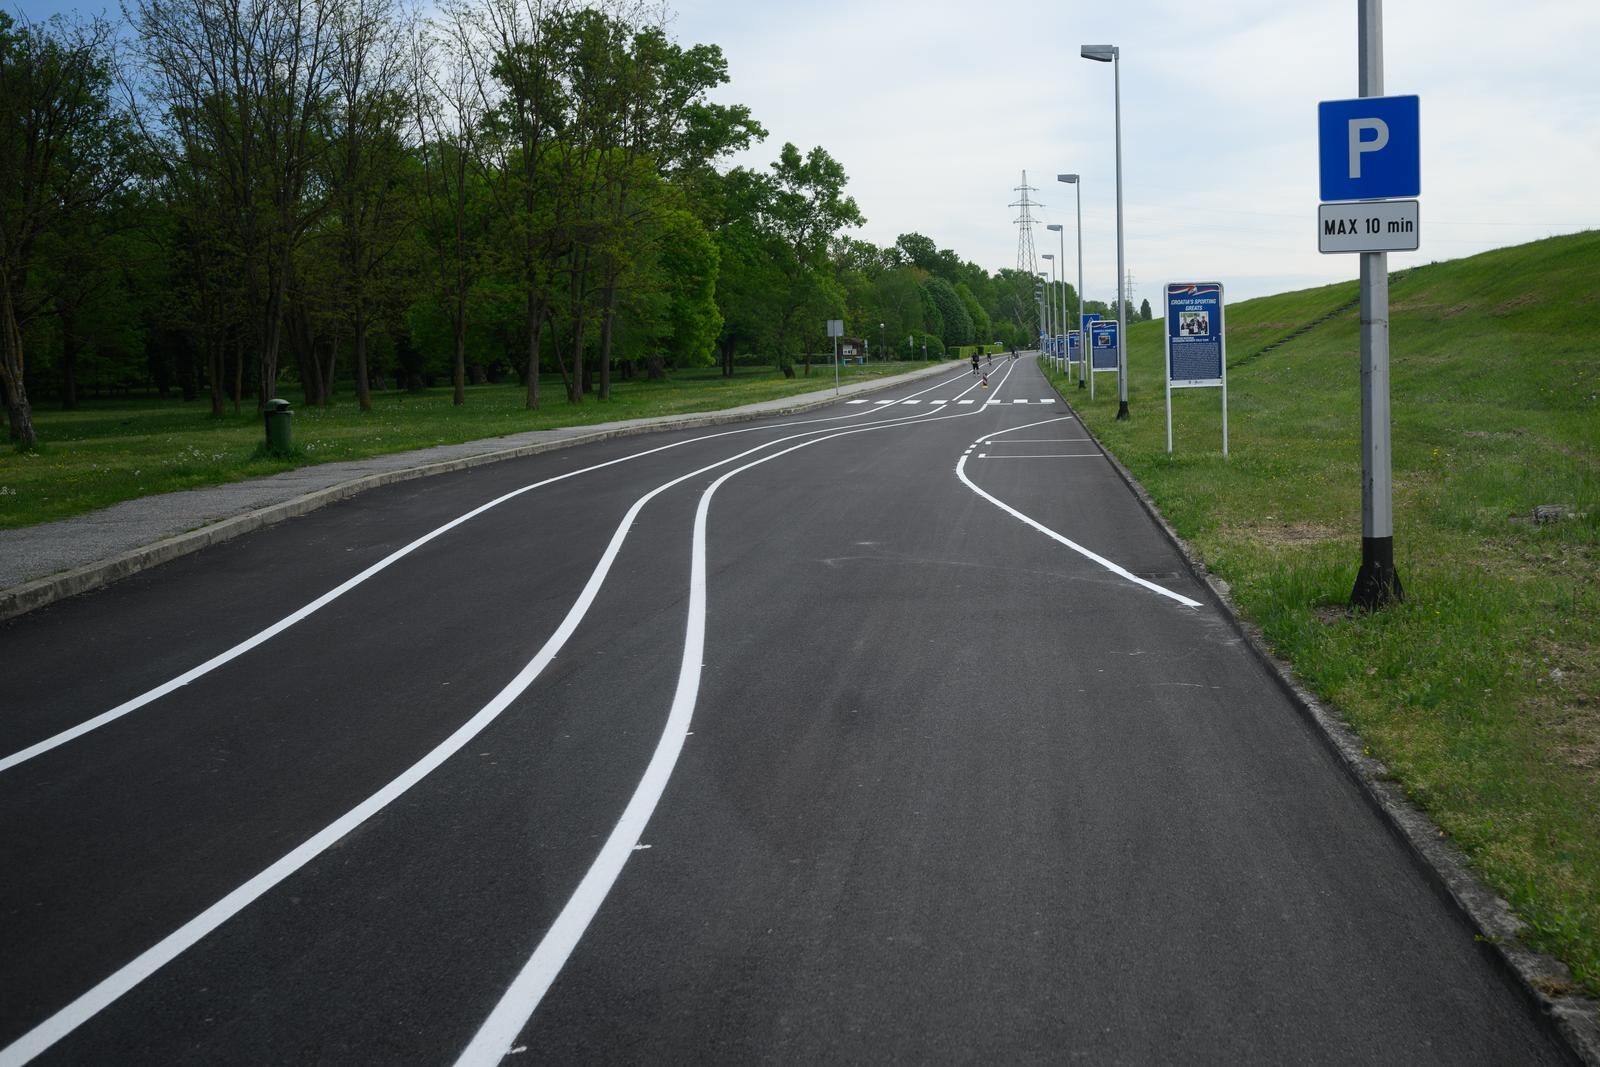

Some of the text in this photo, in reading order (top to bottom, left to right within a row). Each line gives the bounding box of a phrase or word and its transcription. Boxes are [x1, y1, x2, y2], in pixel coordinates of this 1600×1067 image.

[1348, 117, 1389, 179] P
[1324, 217, 1413, 235] MAX 10 min
